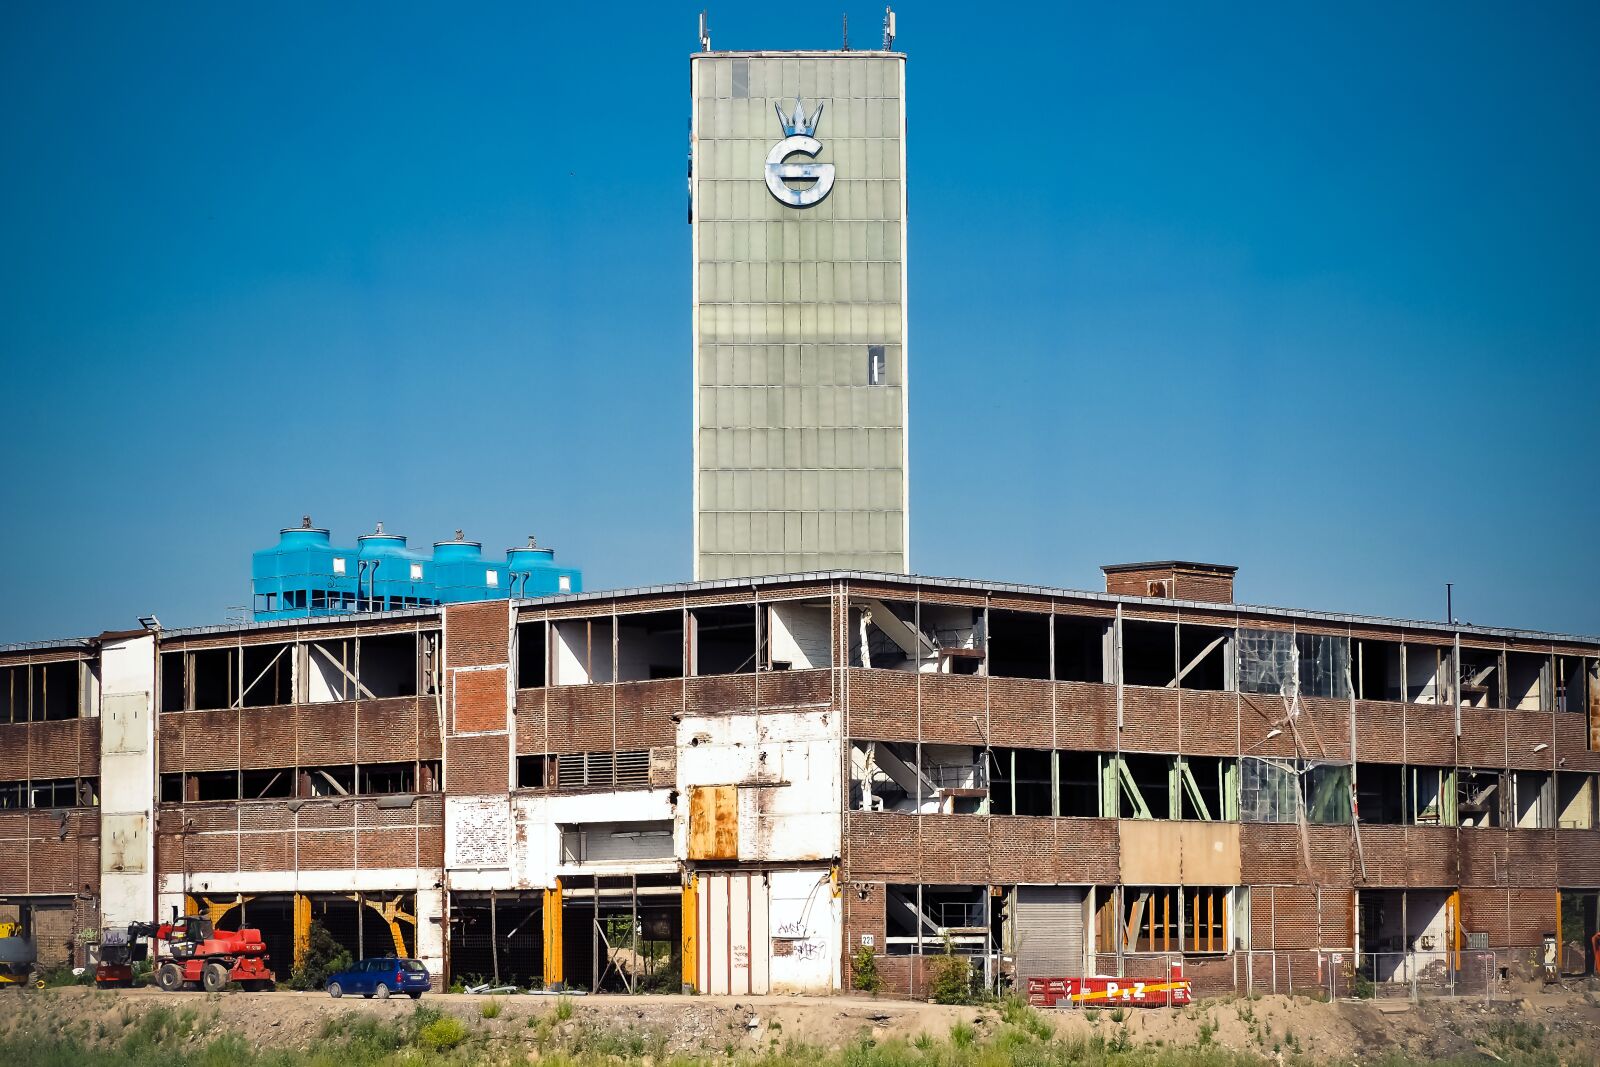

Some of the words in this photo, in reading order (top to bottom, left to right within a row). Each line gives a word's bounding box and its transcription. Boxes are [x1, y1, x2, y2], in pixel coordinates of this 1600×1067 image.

[765, 135, 836, 207] G
[862, 936, 873, 945] 221
[1107, 982, 1119, 998] P
[1133, 982, 1146, 998] Z
